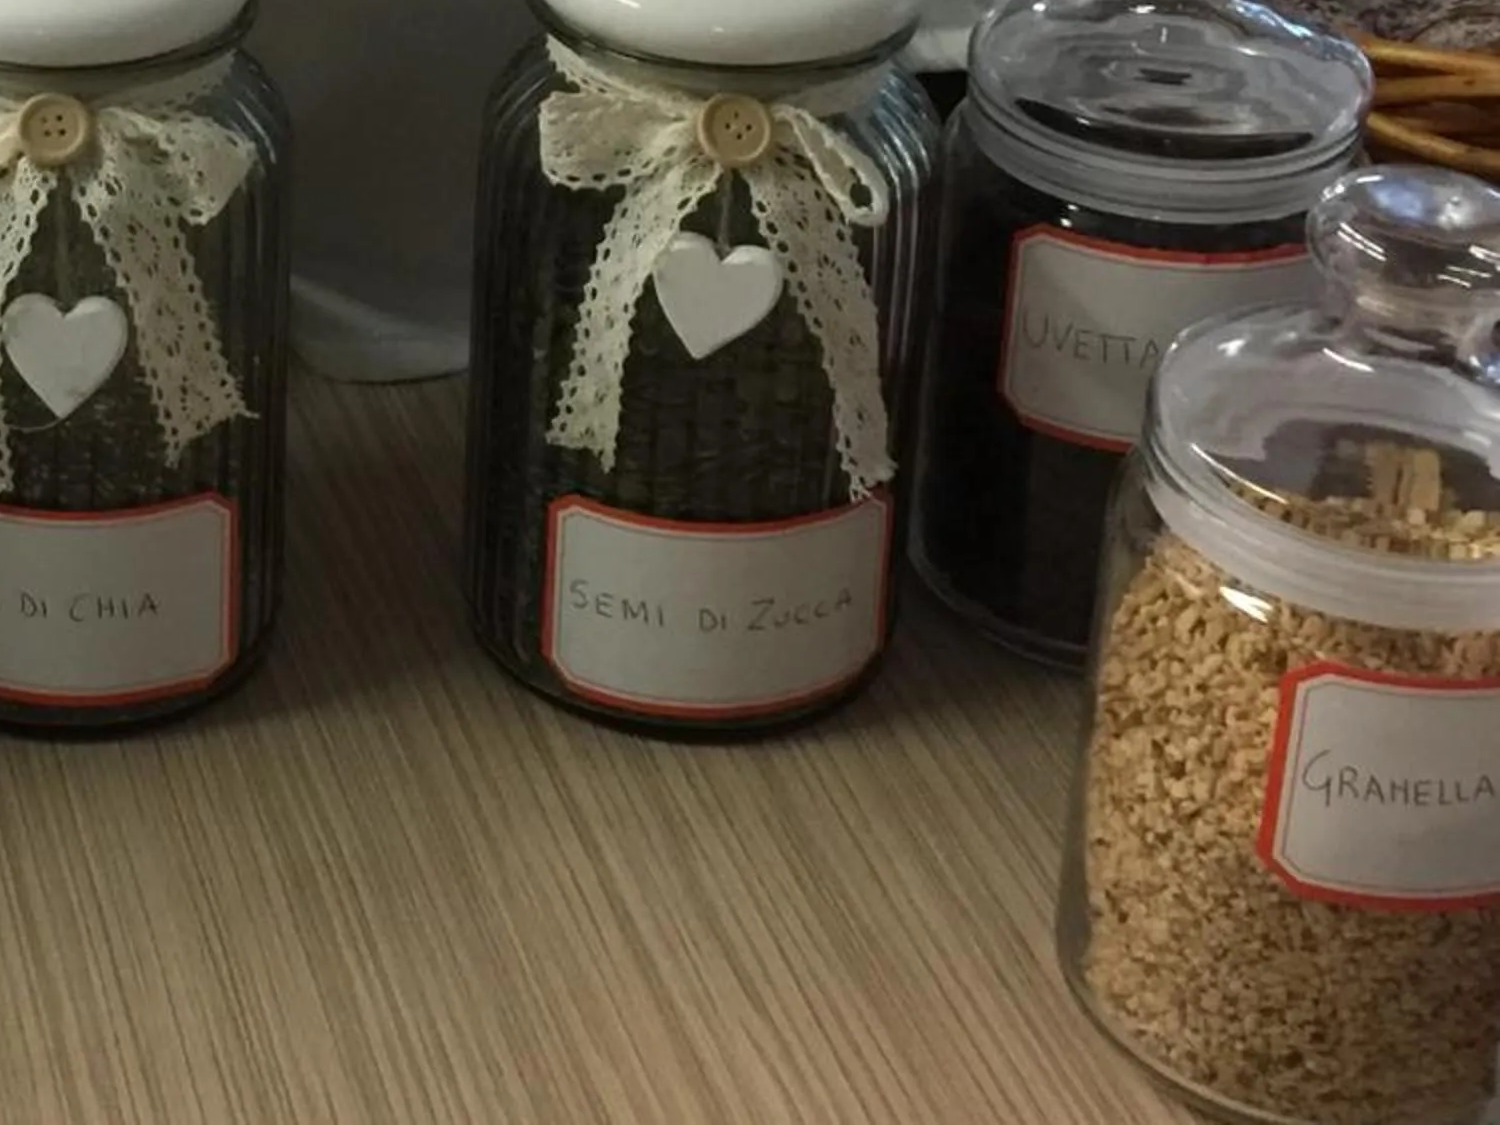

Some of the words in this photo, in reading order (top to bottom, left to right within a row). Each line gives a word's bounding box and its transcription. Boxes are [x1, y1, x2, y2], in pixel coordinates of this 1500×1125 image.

[1022, 306, 1161, 368] UVETTA
[19, 592, 49, 619] DI
[68, 591, 161, 623] CHIA
[569, 579, 665, 627] SEMI
[698, 607, 727, 632] DI
[747, 587, 853, 632] ZUCCA
